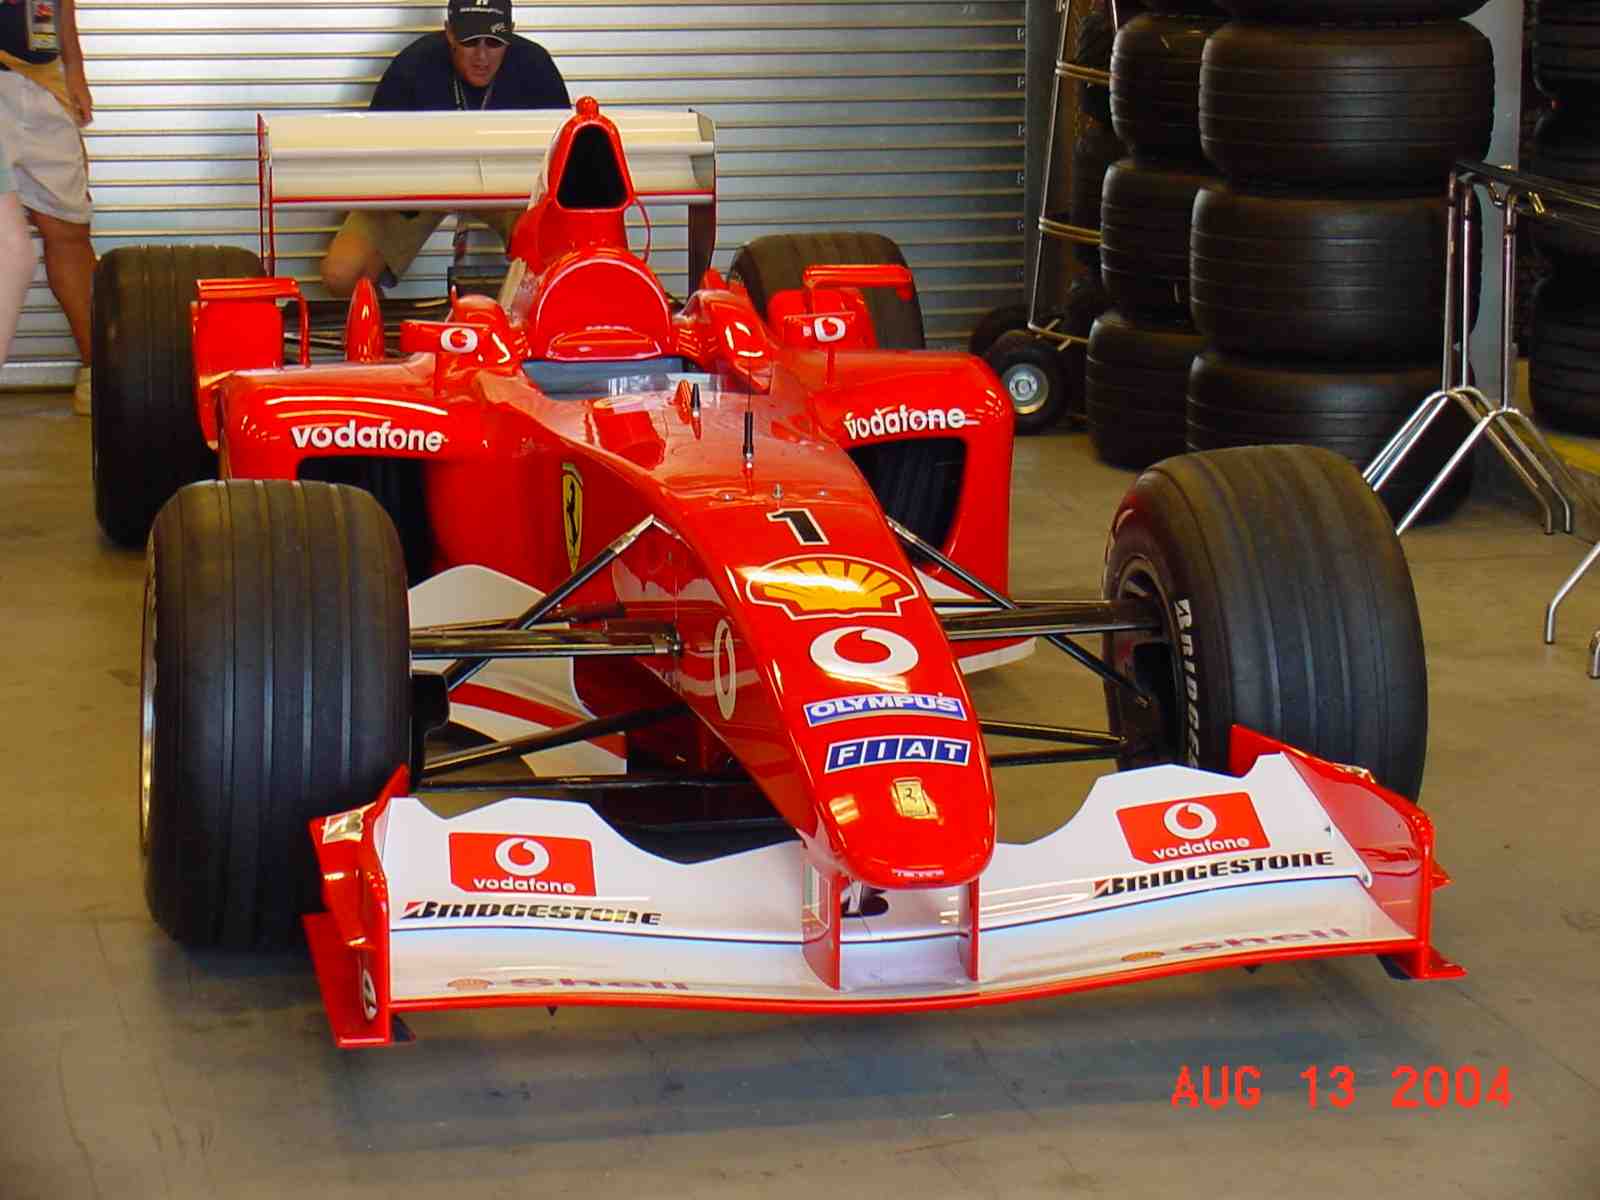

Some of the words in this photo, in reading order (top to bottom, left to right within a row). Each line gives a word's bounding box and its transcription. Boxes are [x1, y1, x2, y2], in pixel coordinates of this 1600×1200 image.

[843, 404, 966, 440] vodafone
[291, 419, 444, 452] vodafone
[766, 508, 830, 545] 1
[810, 694, 959, 717] OLYMPUS
[837, 740, 962, 765] FIAT
[1153, 837, 1250, 860] vodafone
[473, 876, 577, 894] vodafone
[1093, 851, 1335, 898] BRIDGESTONE
[401, 900, 662, 926] BRIDGESTONE
